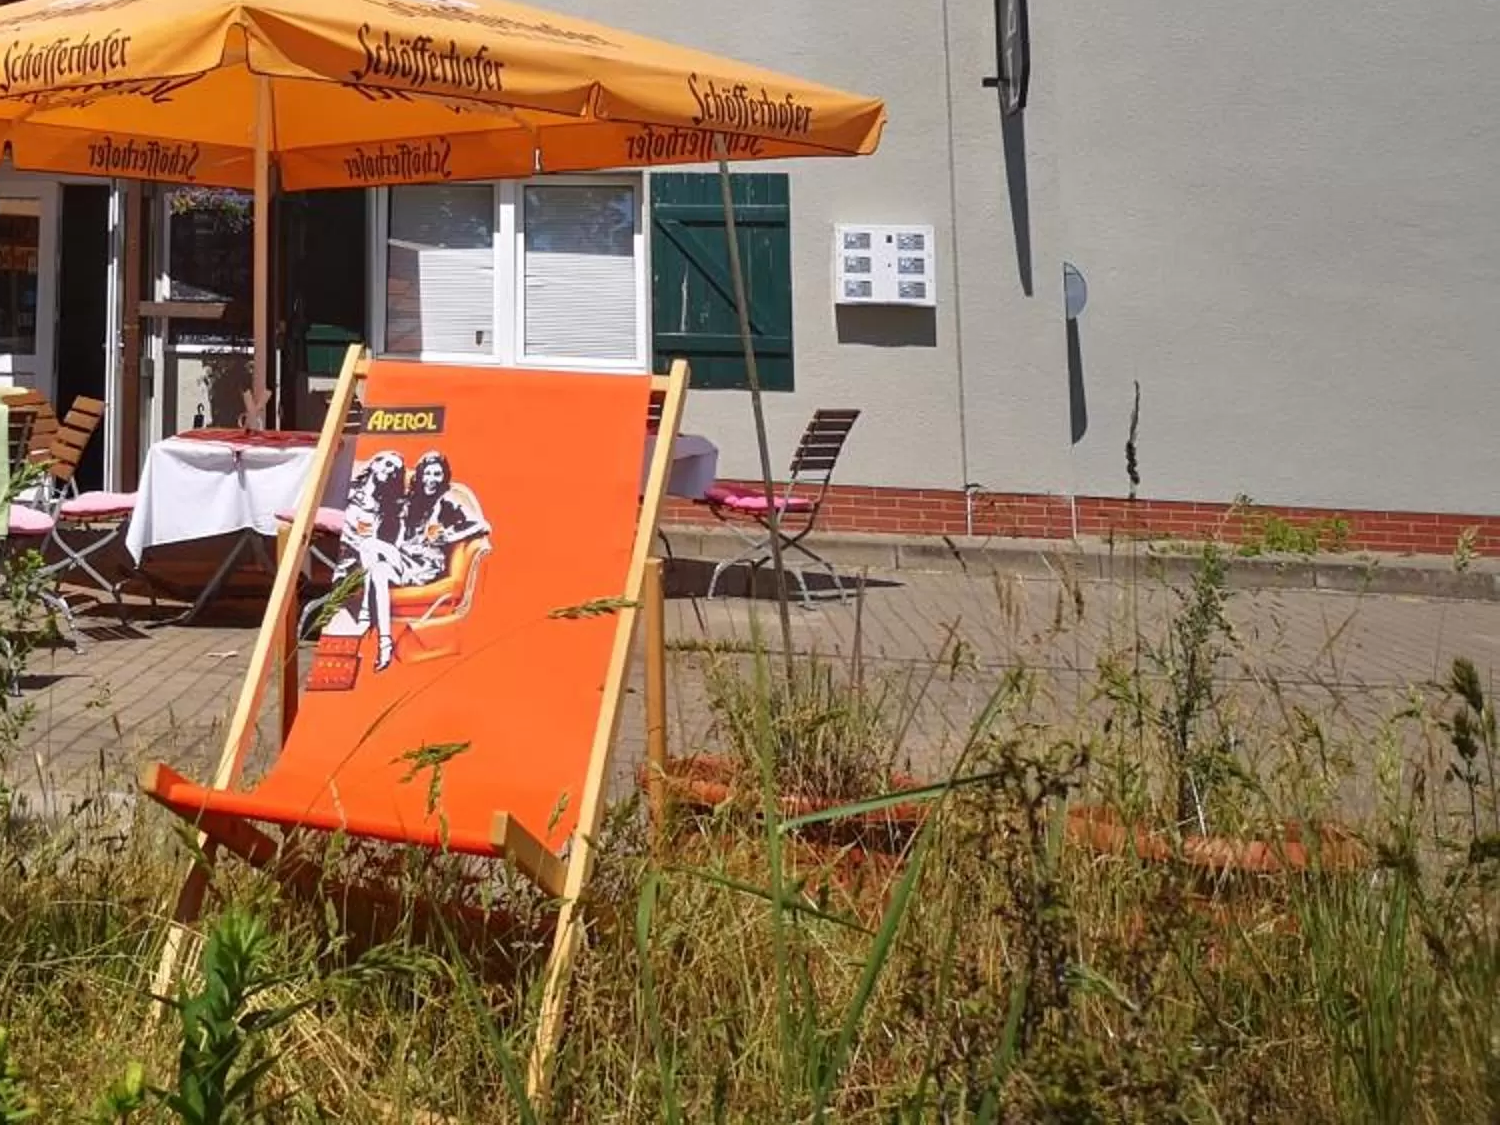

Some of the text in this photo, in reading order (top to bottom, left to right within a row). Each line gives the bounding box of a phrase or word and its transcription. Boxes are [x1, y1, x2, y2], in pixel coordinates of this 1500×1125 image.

[350, 22, 505, 92] Schöfferhofer
[691, 72, 813, 136] Schöfferhofer
[367, 409, 438, 432] APEROL
